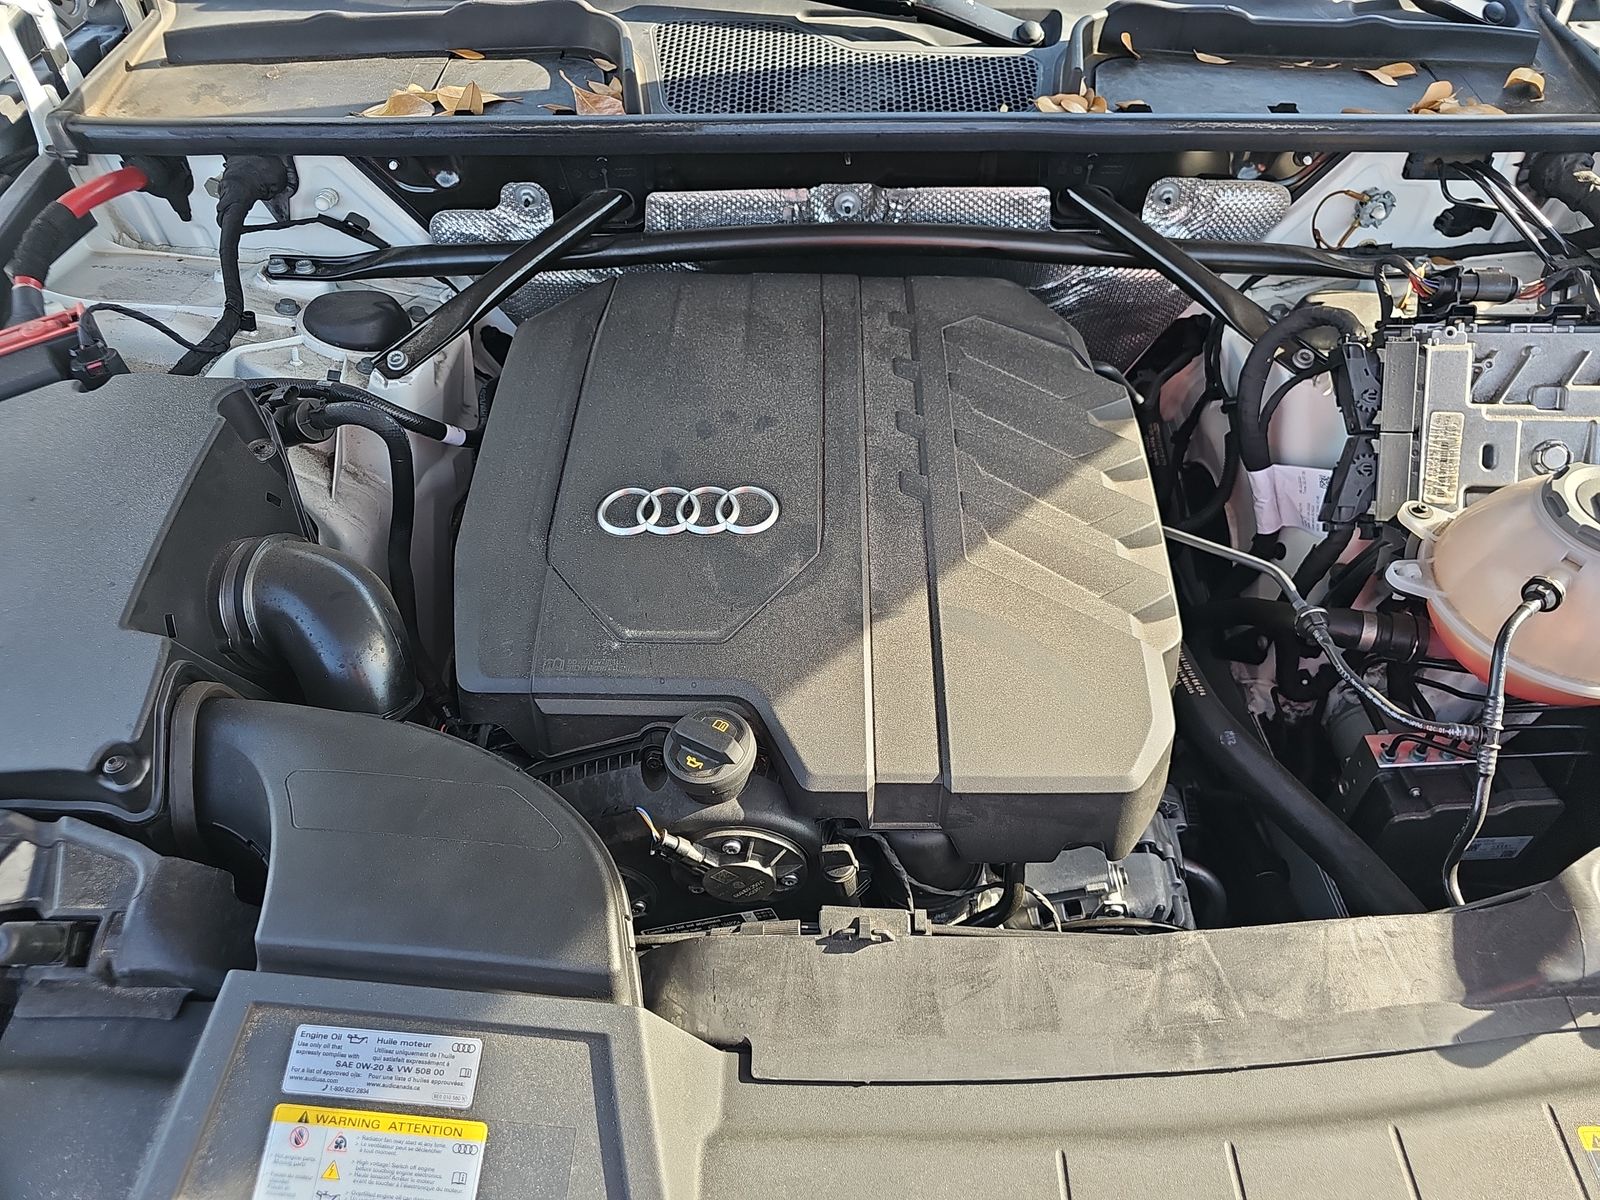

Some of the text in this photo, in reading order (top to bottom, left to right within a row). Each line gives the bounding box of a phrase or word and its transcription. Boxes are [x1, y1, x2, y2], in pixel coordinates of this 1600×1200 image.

[300, 1031, 328, 1040] Engine
[376, 1036, 432, 1048] Huile moteur
[396, 1048, 428, 1058] uniquement
[336, 1060, 354, 1068] SAE
[356, 1062, 384, 1071] 0W-20
[289, 1075, 338, 1083] www.audiusa.com
[330, 1085, 369, 1094] 1-800-822-2834
[367, 1082, 420, 1091] www.audicanada.ca
[316, 1114, 464, 1137] WARNING ATTENTION
